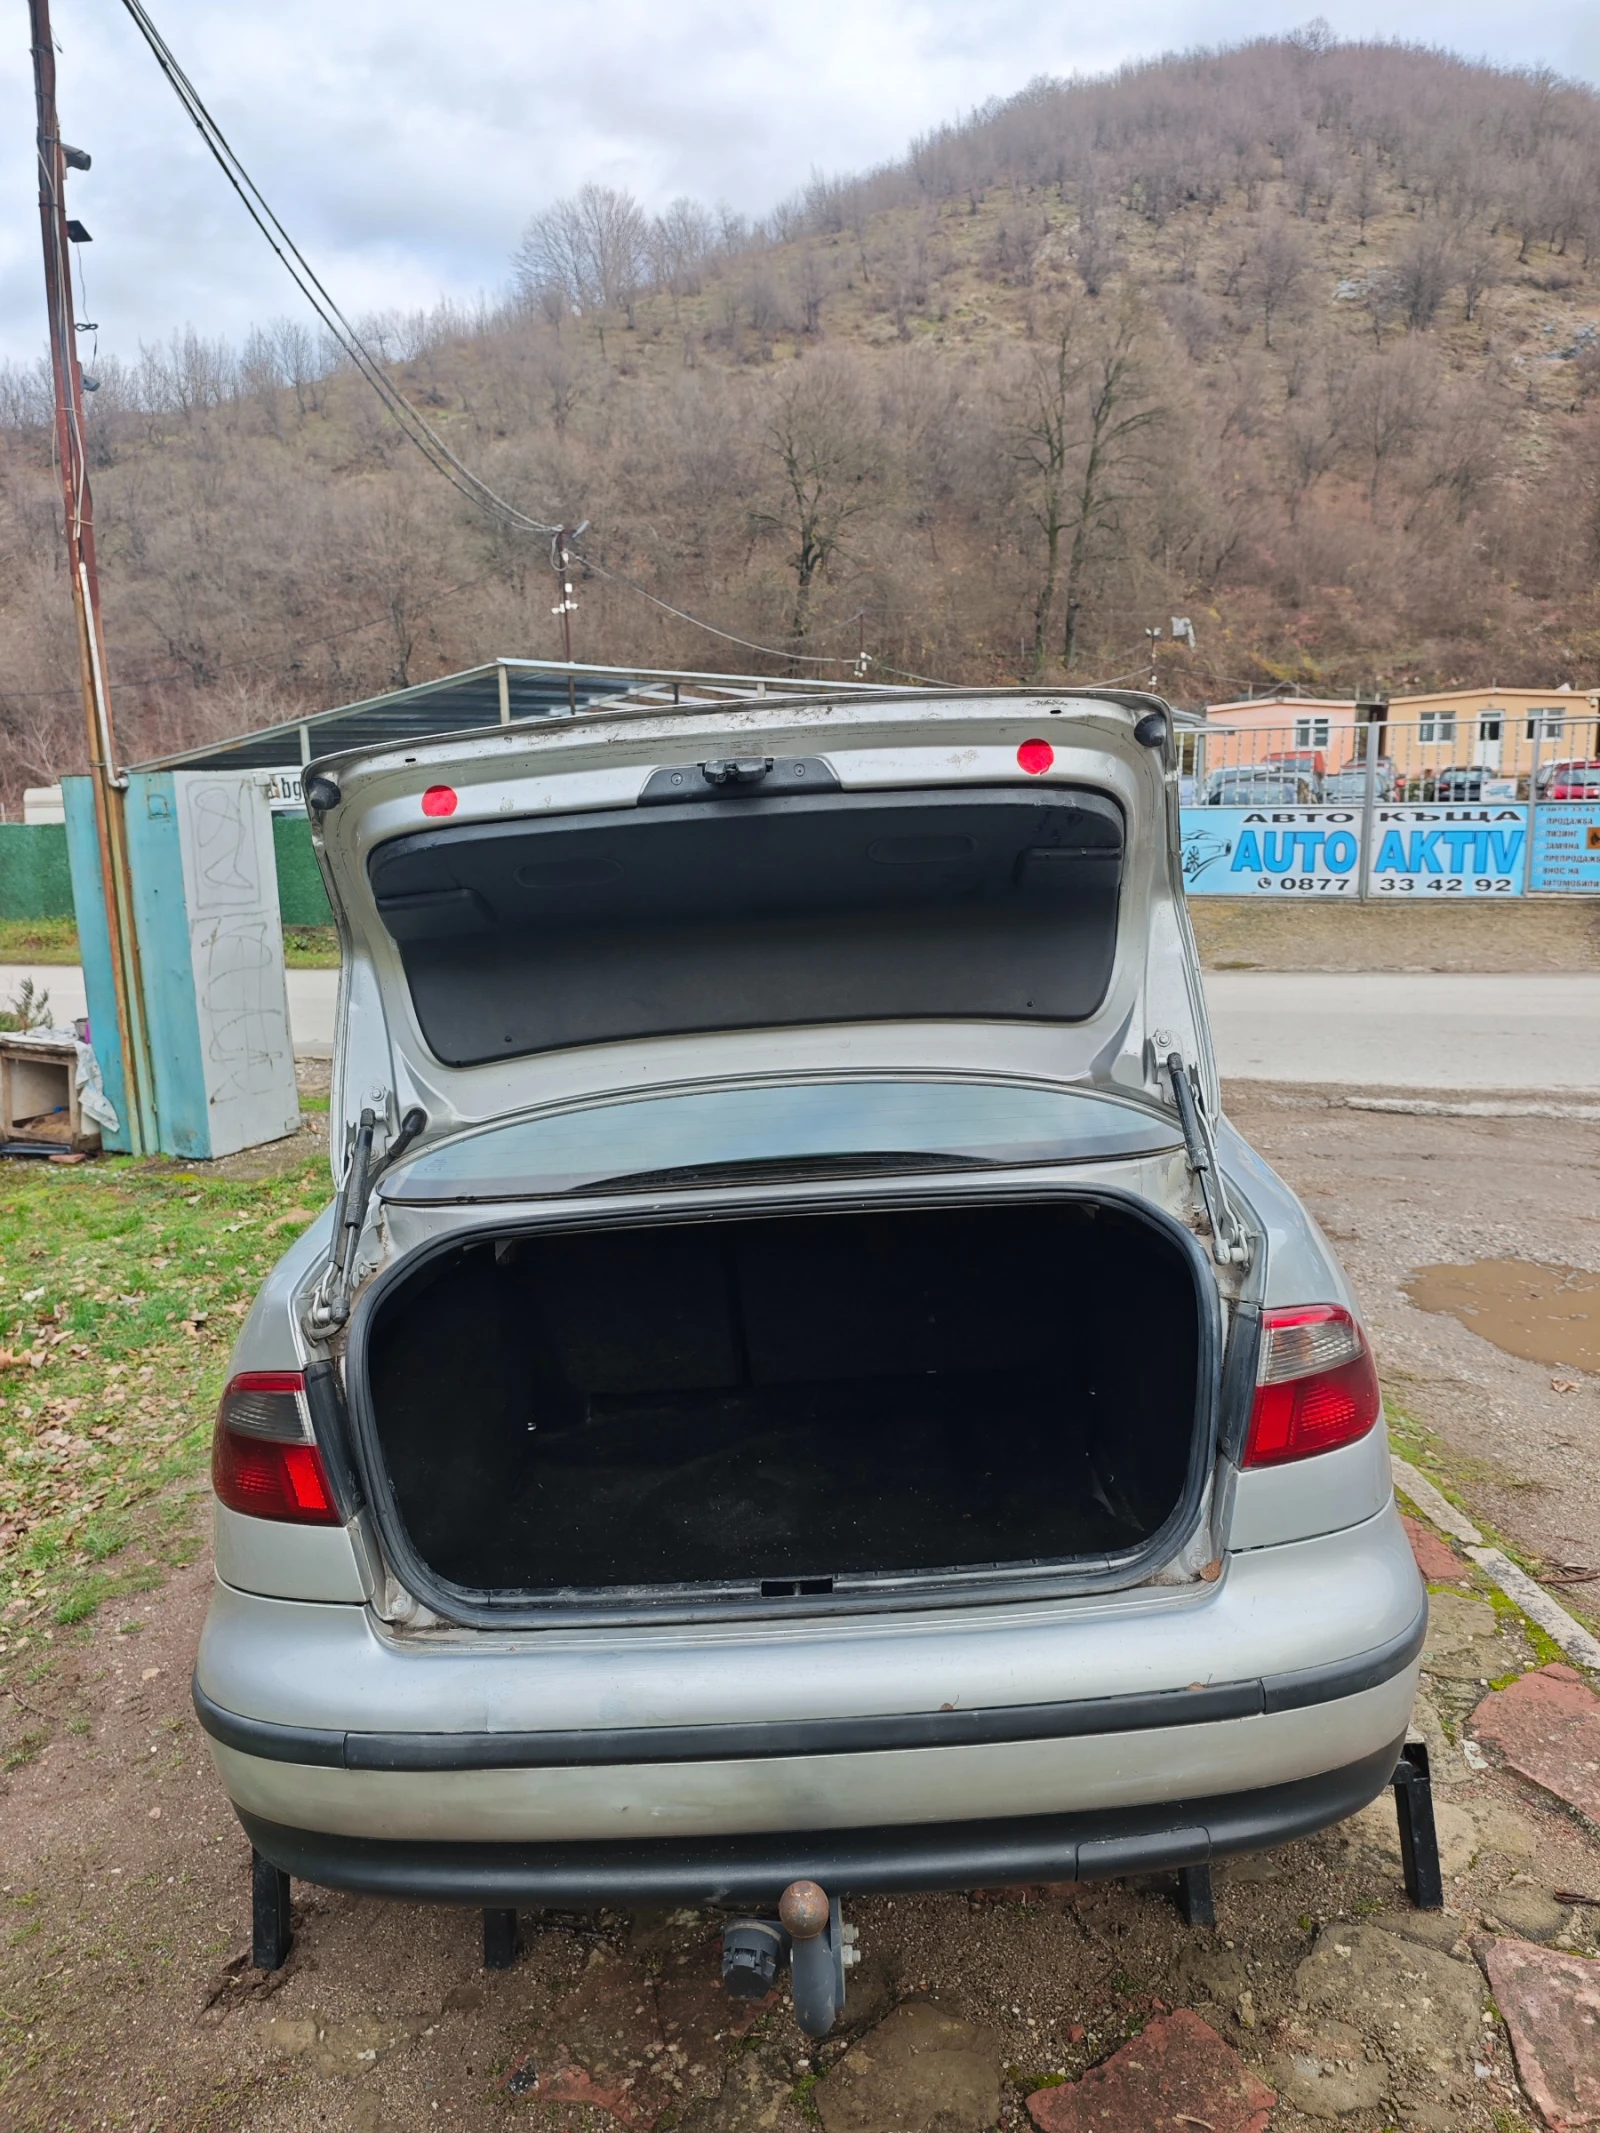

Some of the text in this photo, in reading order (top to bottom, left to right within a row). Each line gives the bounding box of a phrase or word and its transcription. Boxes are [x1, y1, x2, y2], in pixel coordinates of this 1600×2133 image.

[1243, 811, 1521, 824] АВТО КЪЩА
[1546, 817, 1593, 825] ПРОДАЖБА
[1230, 830, 1525, 874] AUTO AKTIV
[1280, 877, 1512, 892] 0877 33 42 92
